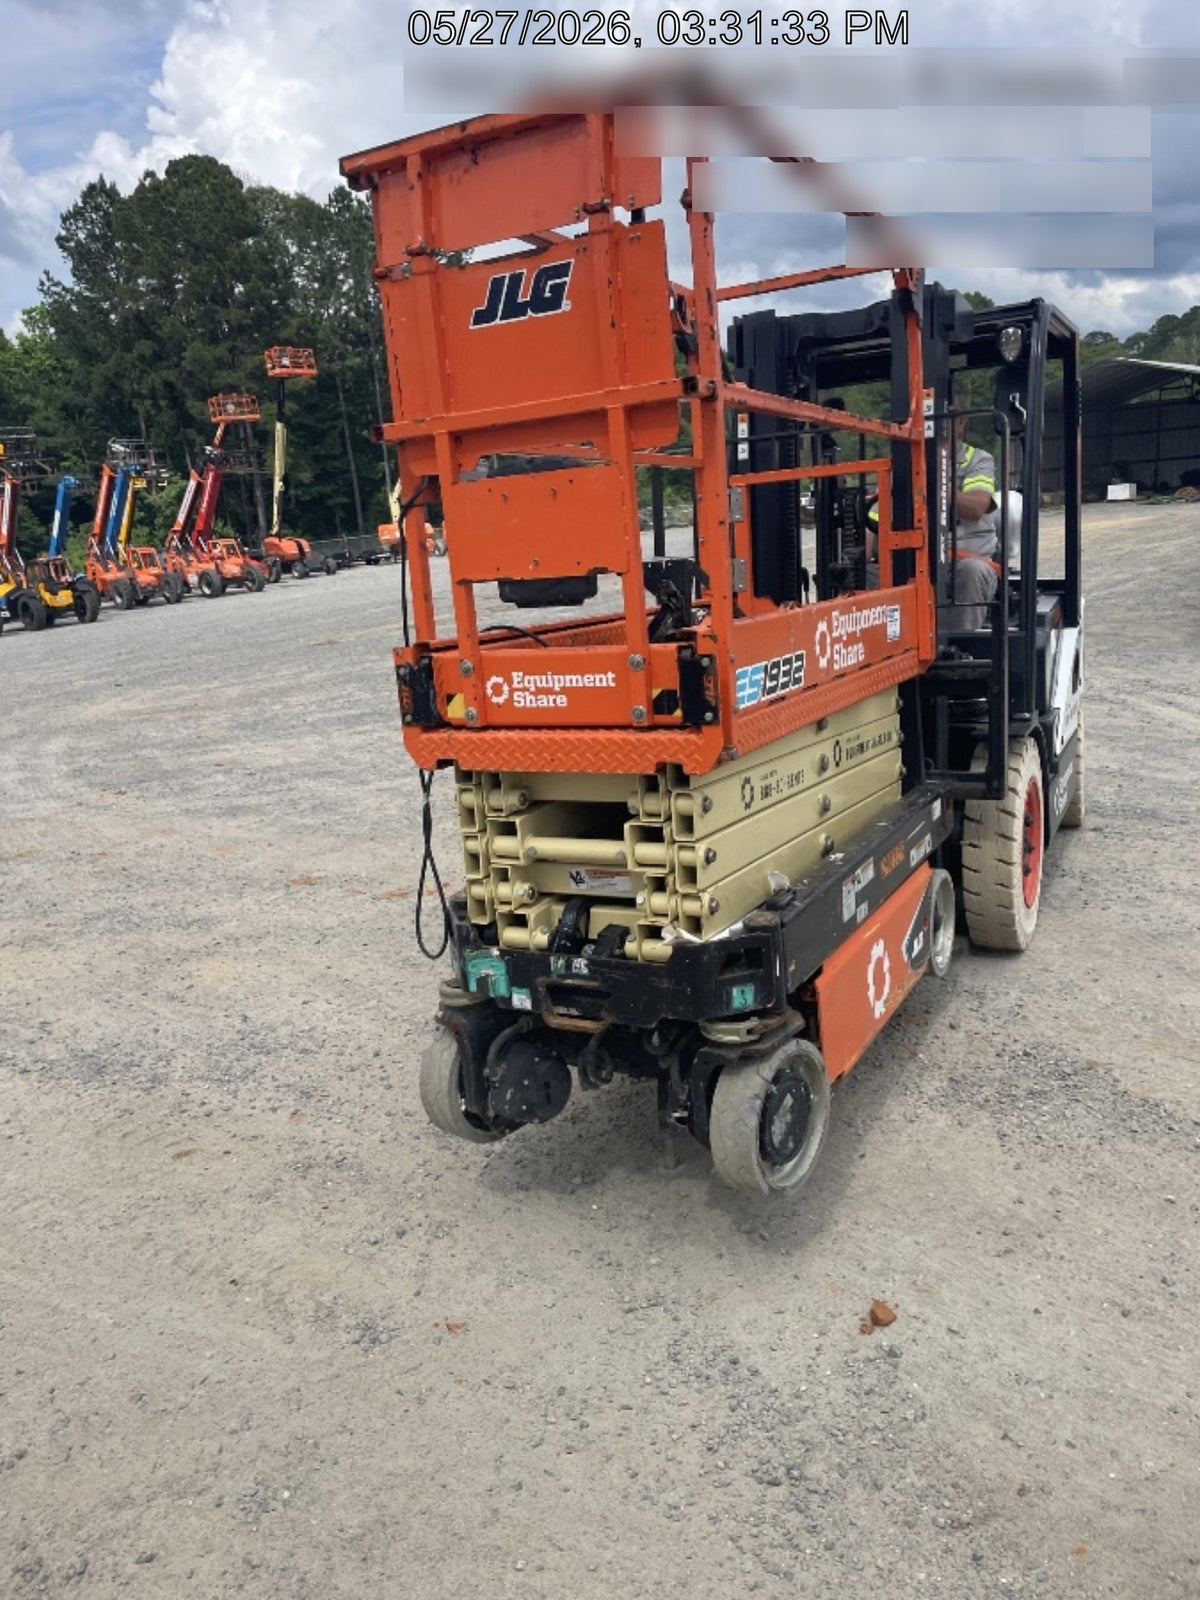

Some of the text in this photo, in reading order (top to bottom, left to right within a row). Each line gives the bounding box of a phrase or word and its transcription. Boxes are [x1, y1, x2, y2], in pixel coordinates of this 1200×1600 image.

[469, 259, 574, 329] JLG
[833, 641, 865, 670] Share
[512, 671, 616, 691] Equipment
[736, 650, 806, 710] ES1932
[513, 691, 568, 707] Share
